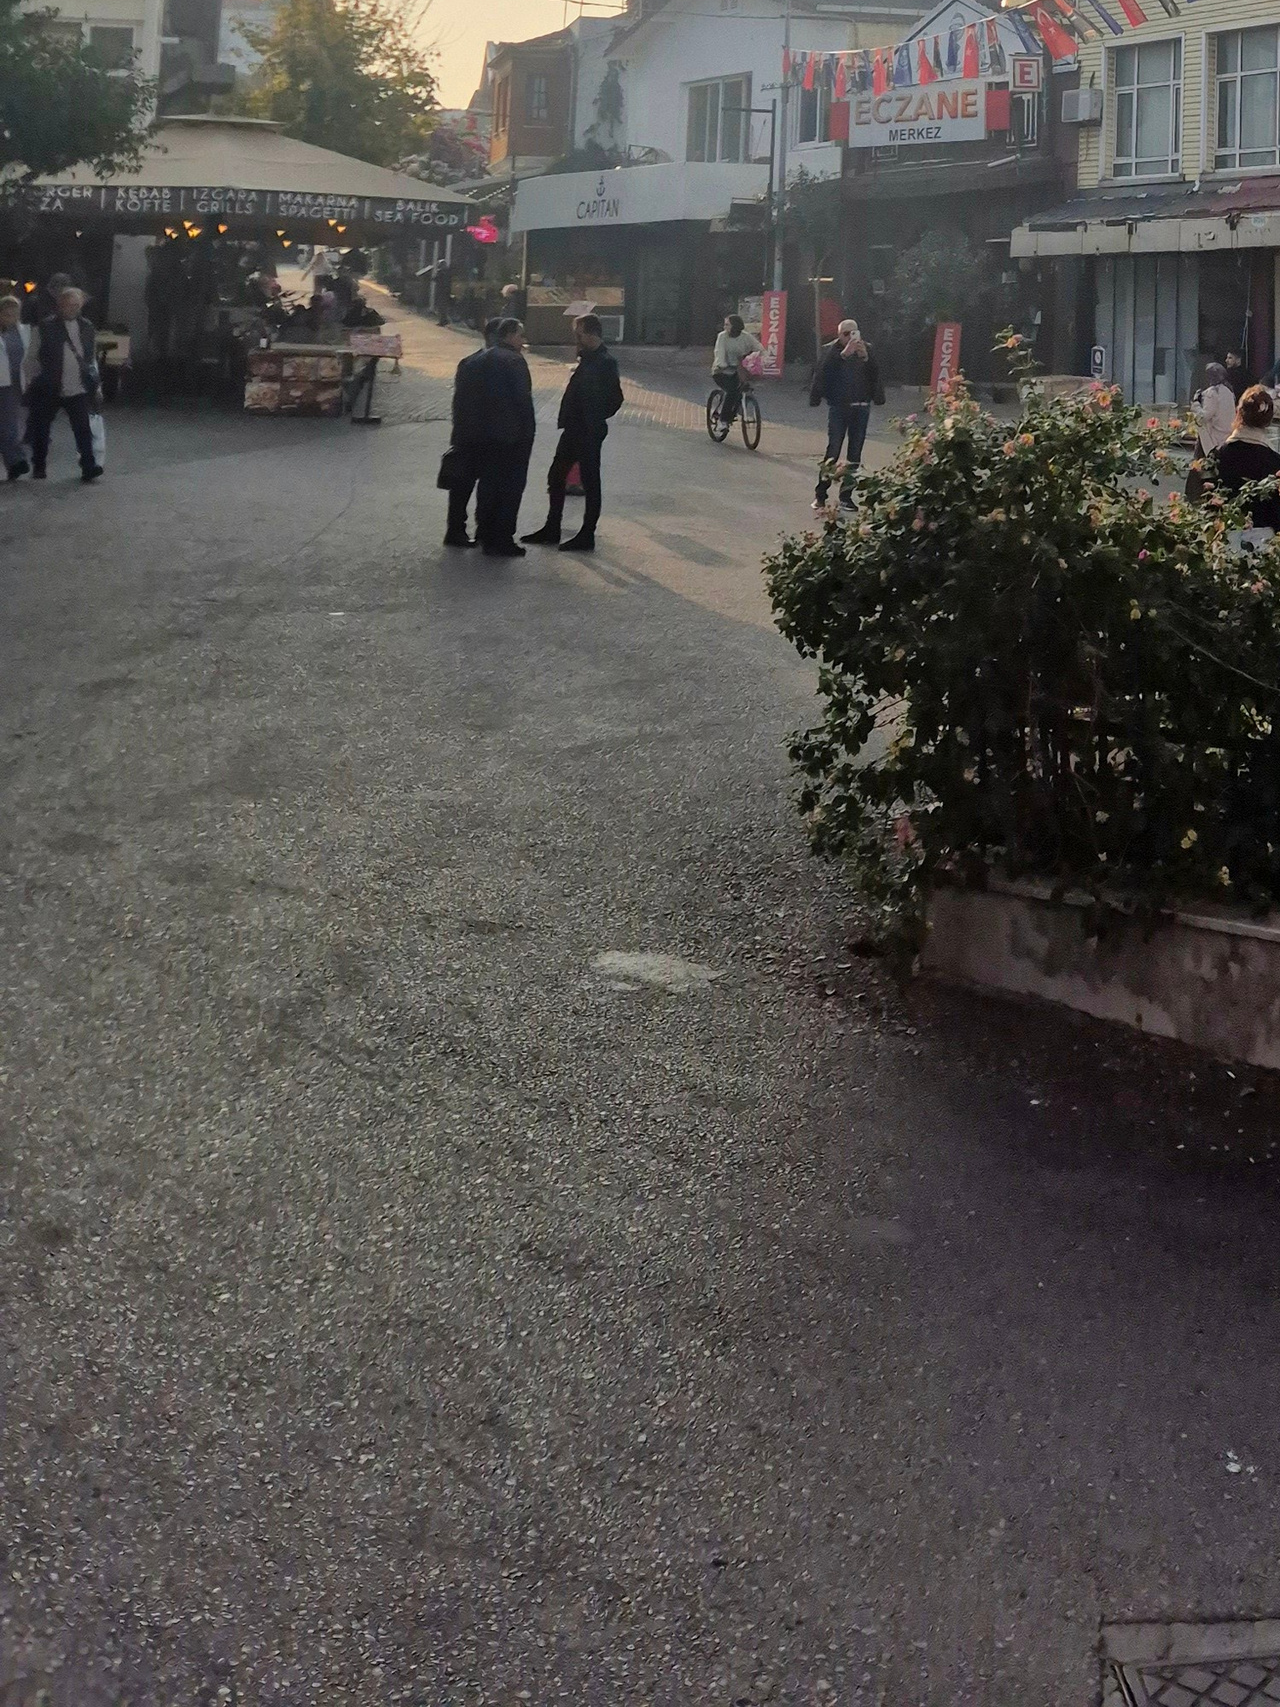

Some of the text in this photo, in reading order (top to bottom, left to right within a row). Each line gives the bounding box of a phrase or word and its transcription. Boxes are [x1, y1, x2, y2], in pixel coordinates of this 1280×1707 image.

[1019, 63, 1033, 84] E
[855, 89, 979, 125] ECZANE
[888, 127, 942, 142] MERKEZ
[117, 187, 171, 199] KEBAB
[279, 193, 359, 208] MAKARNA
[196, 201, 253, 214] GRILLS
[279, 204, 356, 220] SPAGETTI
[576, 199, 620, 220] CAPITAN
[374, 210, 459, 225] SEA FOOD
[936, 328, 955, 393] ECZA
